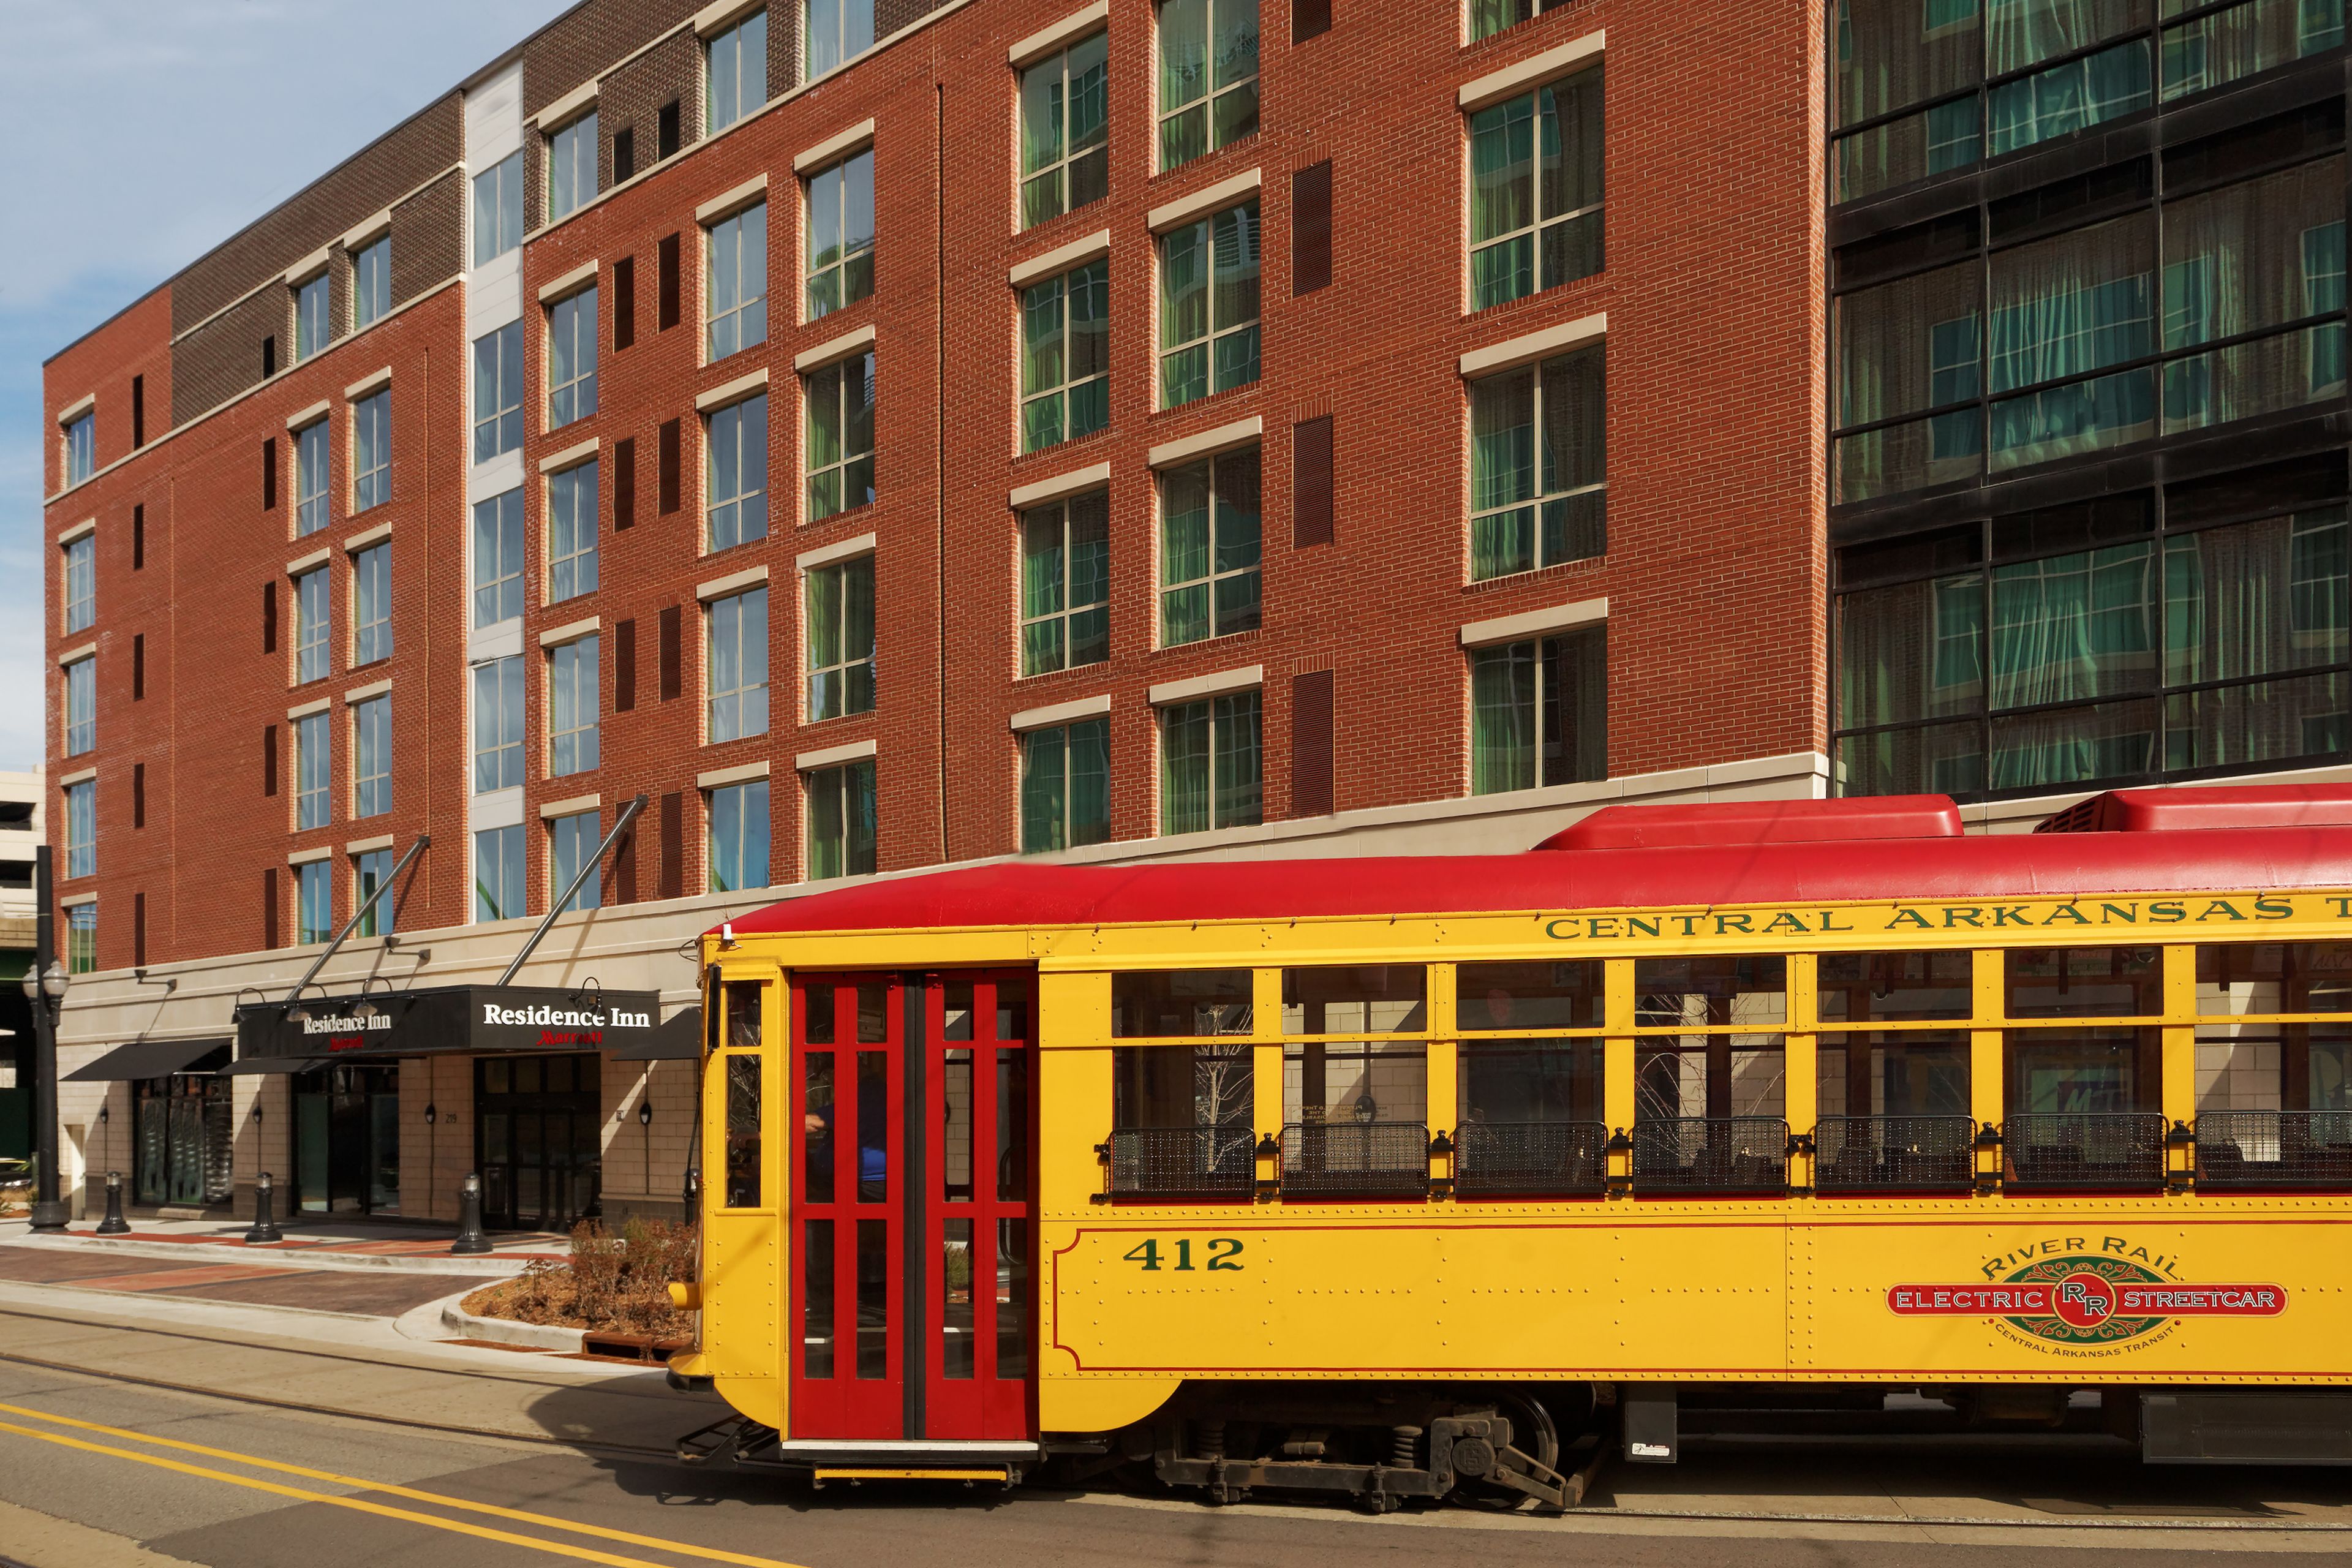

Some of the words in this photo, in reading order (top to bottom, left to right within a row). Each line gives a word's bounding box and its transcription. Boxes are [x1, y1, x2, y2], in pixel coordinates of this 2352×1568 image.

[1546, 911, 1854, 939] CENTRAL
[1884, 899, 2293, 929] ARKANSAS
[303, 1014, 365, 1035] Residence
[367, 1014, 392, 1030] Inn
[483, 1004, 605, 1027] Residence
[609, 1008, 650, 1027] Inn
[536, 1030, 603, 1046] Marriott
[1123, 1238, 1245, 1271] 412
[1981, 1237, 2086, 1281] RIVER
[2101, 1236, 2179, 1281] RAIL
[1896, 1292, 2043, 1308] ELECTRIC
[2124, 1291, 2276, 1308] STREETCAR
[1995, 1324, 2048, 1354] CENTRAL
[2052, 1347, 2121, 1358] ARKANSAS
[2124, 1325, 2174, 1353] TRANSIT
